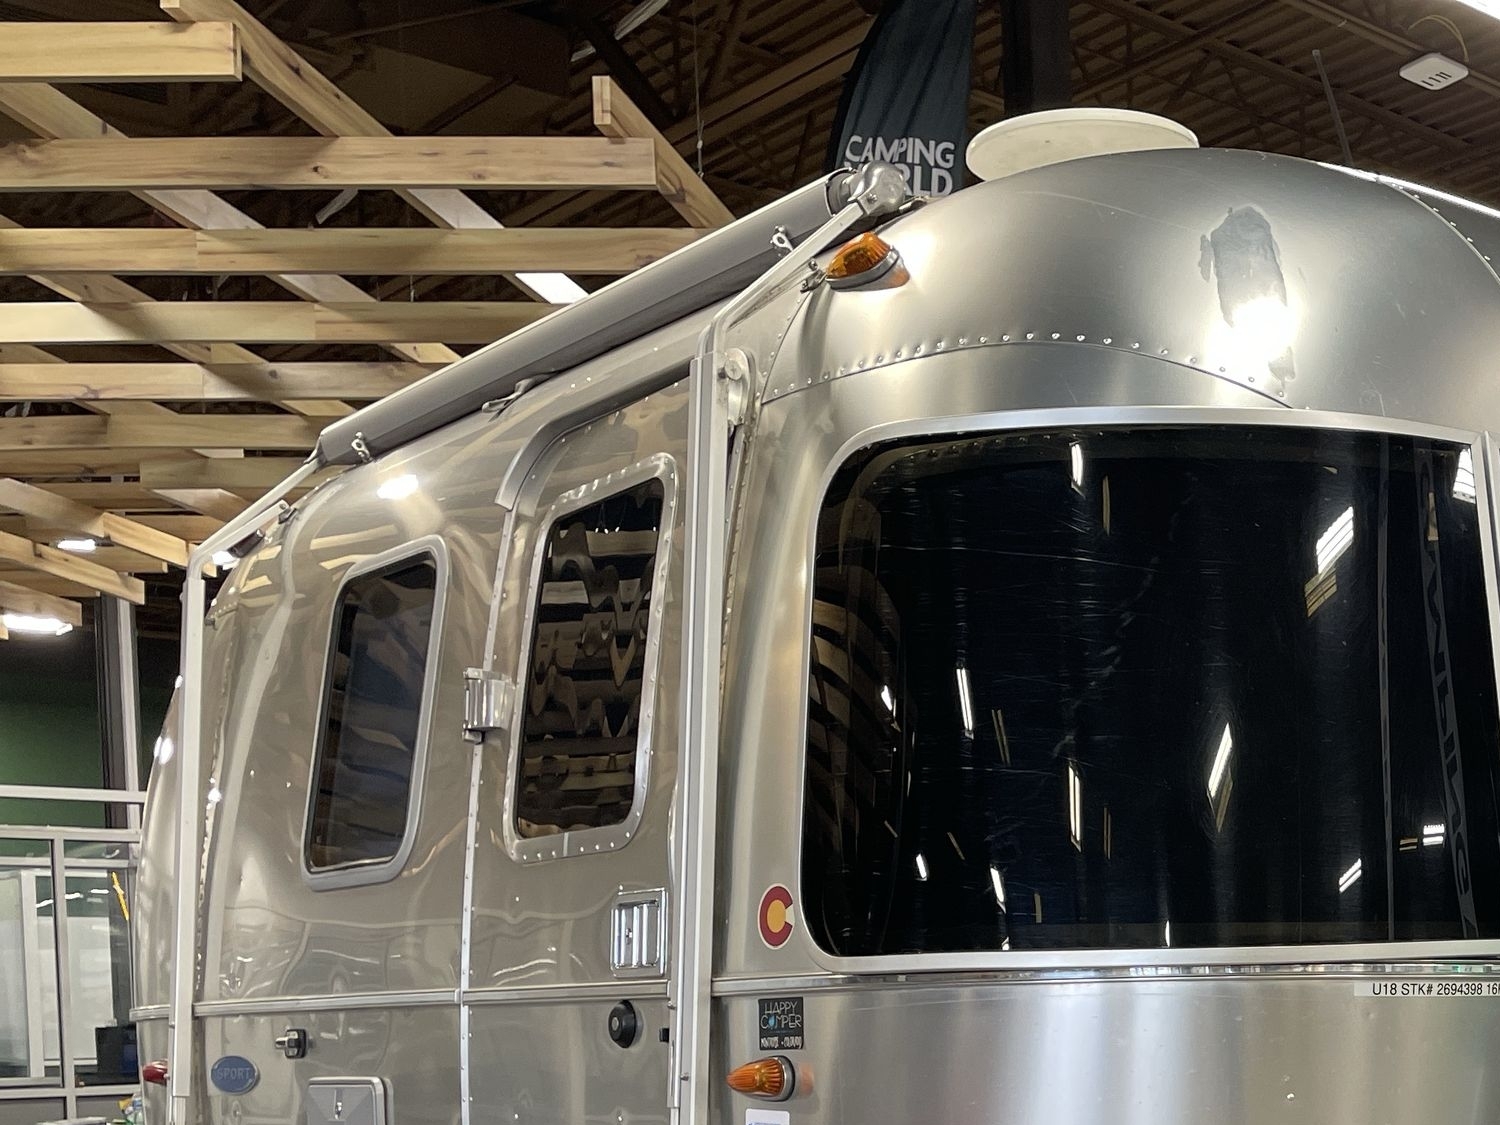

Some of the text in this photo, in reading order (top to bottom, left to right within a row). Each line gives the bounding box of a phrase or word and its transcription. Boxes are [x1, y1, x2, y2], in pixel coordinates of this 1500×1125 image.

[845, 135, 955, 169] CAMPING
[1372, 983, 1397, 996] U18
[1401, 983, 1433, 996] STK#
[1437, 983, 1483, 996] 2694398
[764, 1001, 798, 1014] HAPPY
[760, 1014, 802, 1029] CMPER
[217, 1067, 250, 1081] SPORT
